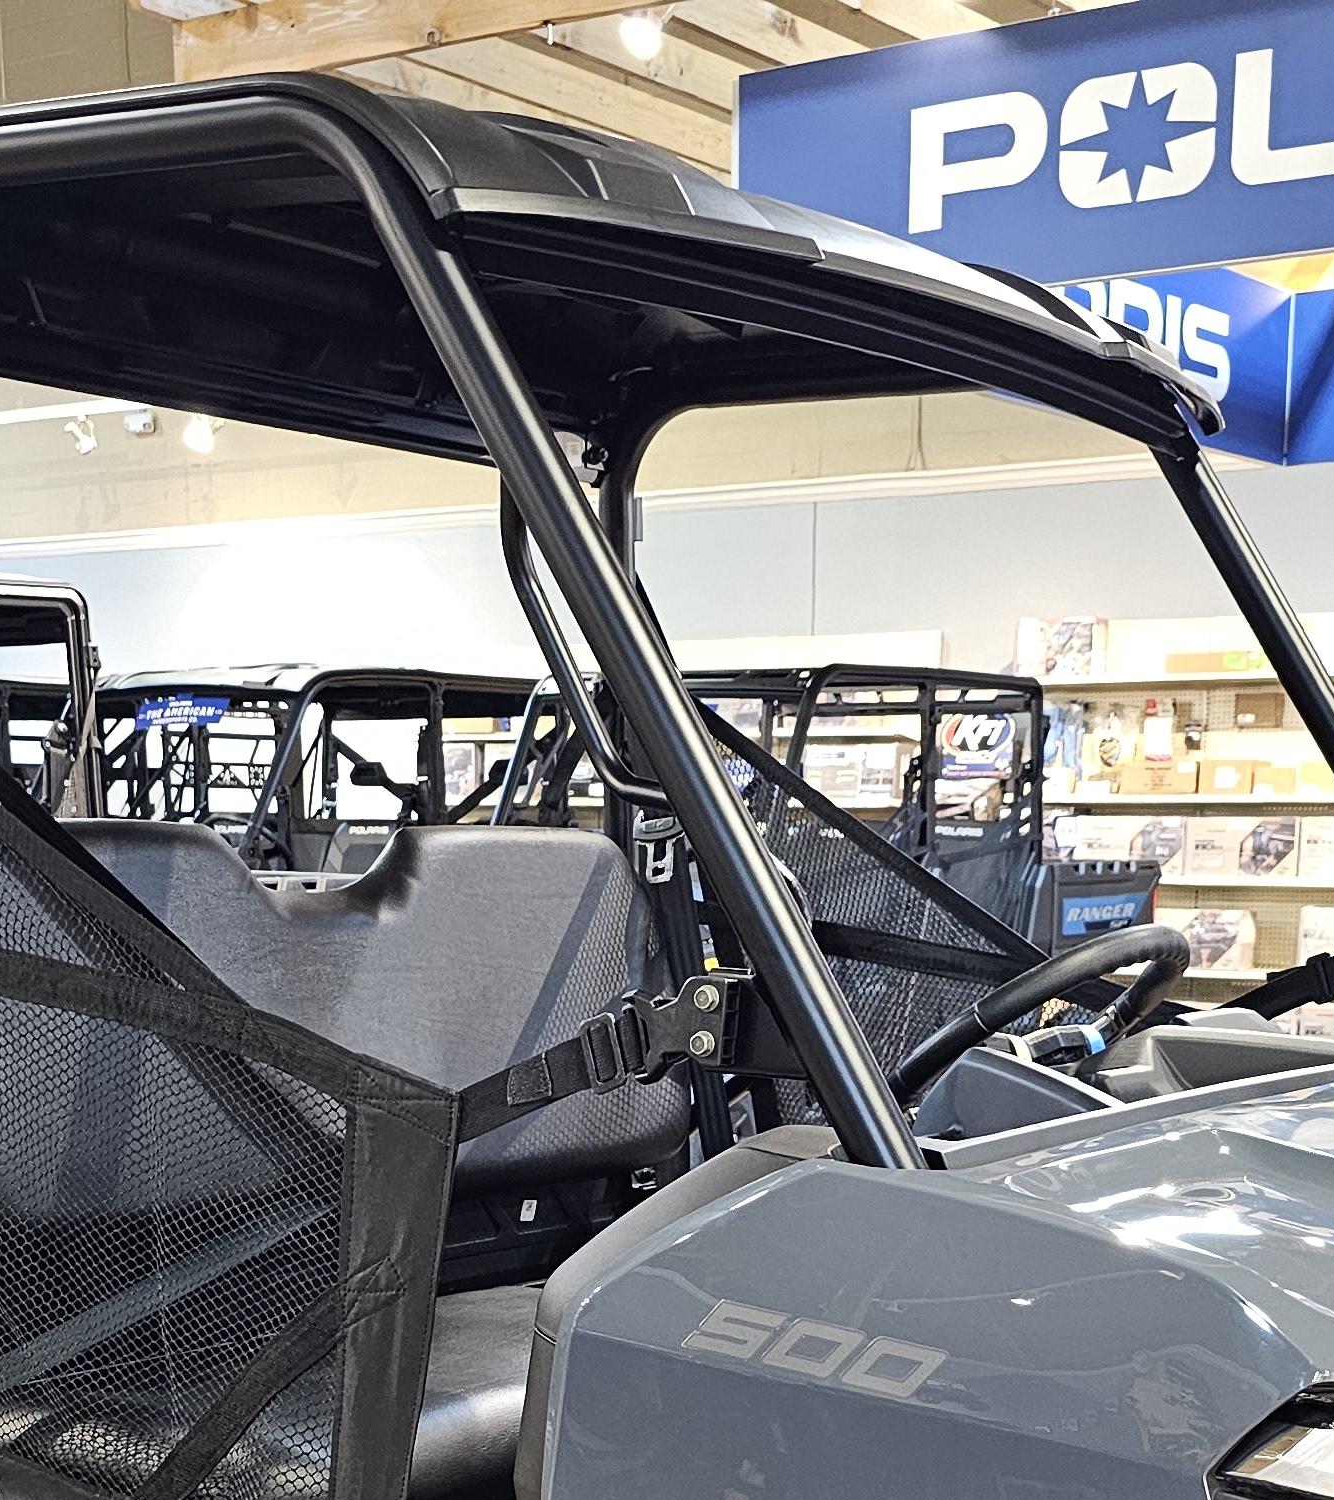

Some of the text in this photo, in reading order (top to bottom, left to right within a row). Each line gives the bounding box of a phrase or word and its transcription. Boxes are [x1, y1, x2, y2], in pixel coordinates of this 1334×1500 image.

[163, 706, 216, 717] AMERICAN
[348, 825, 390, 835] POLARIS
[1066, 902, 1136, 922] RANGER
[681, 1299, 950, 1397] 500
